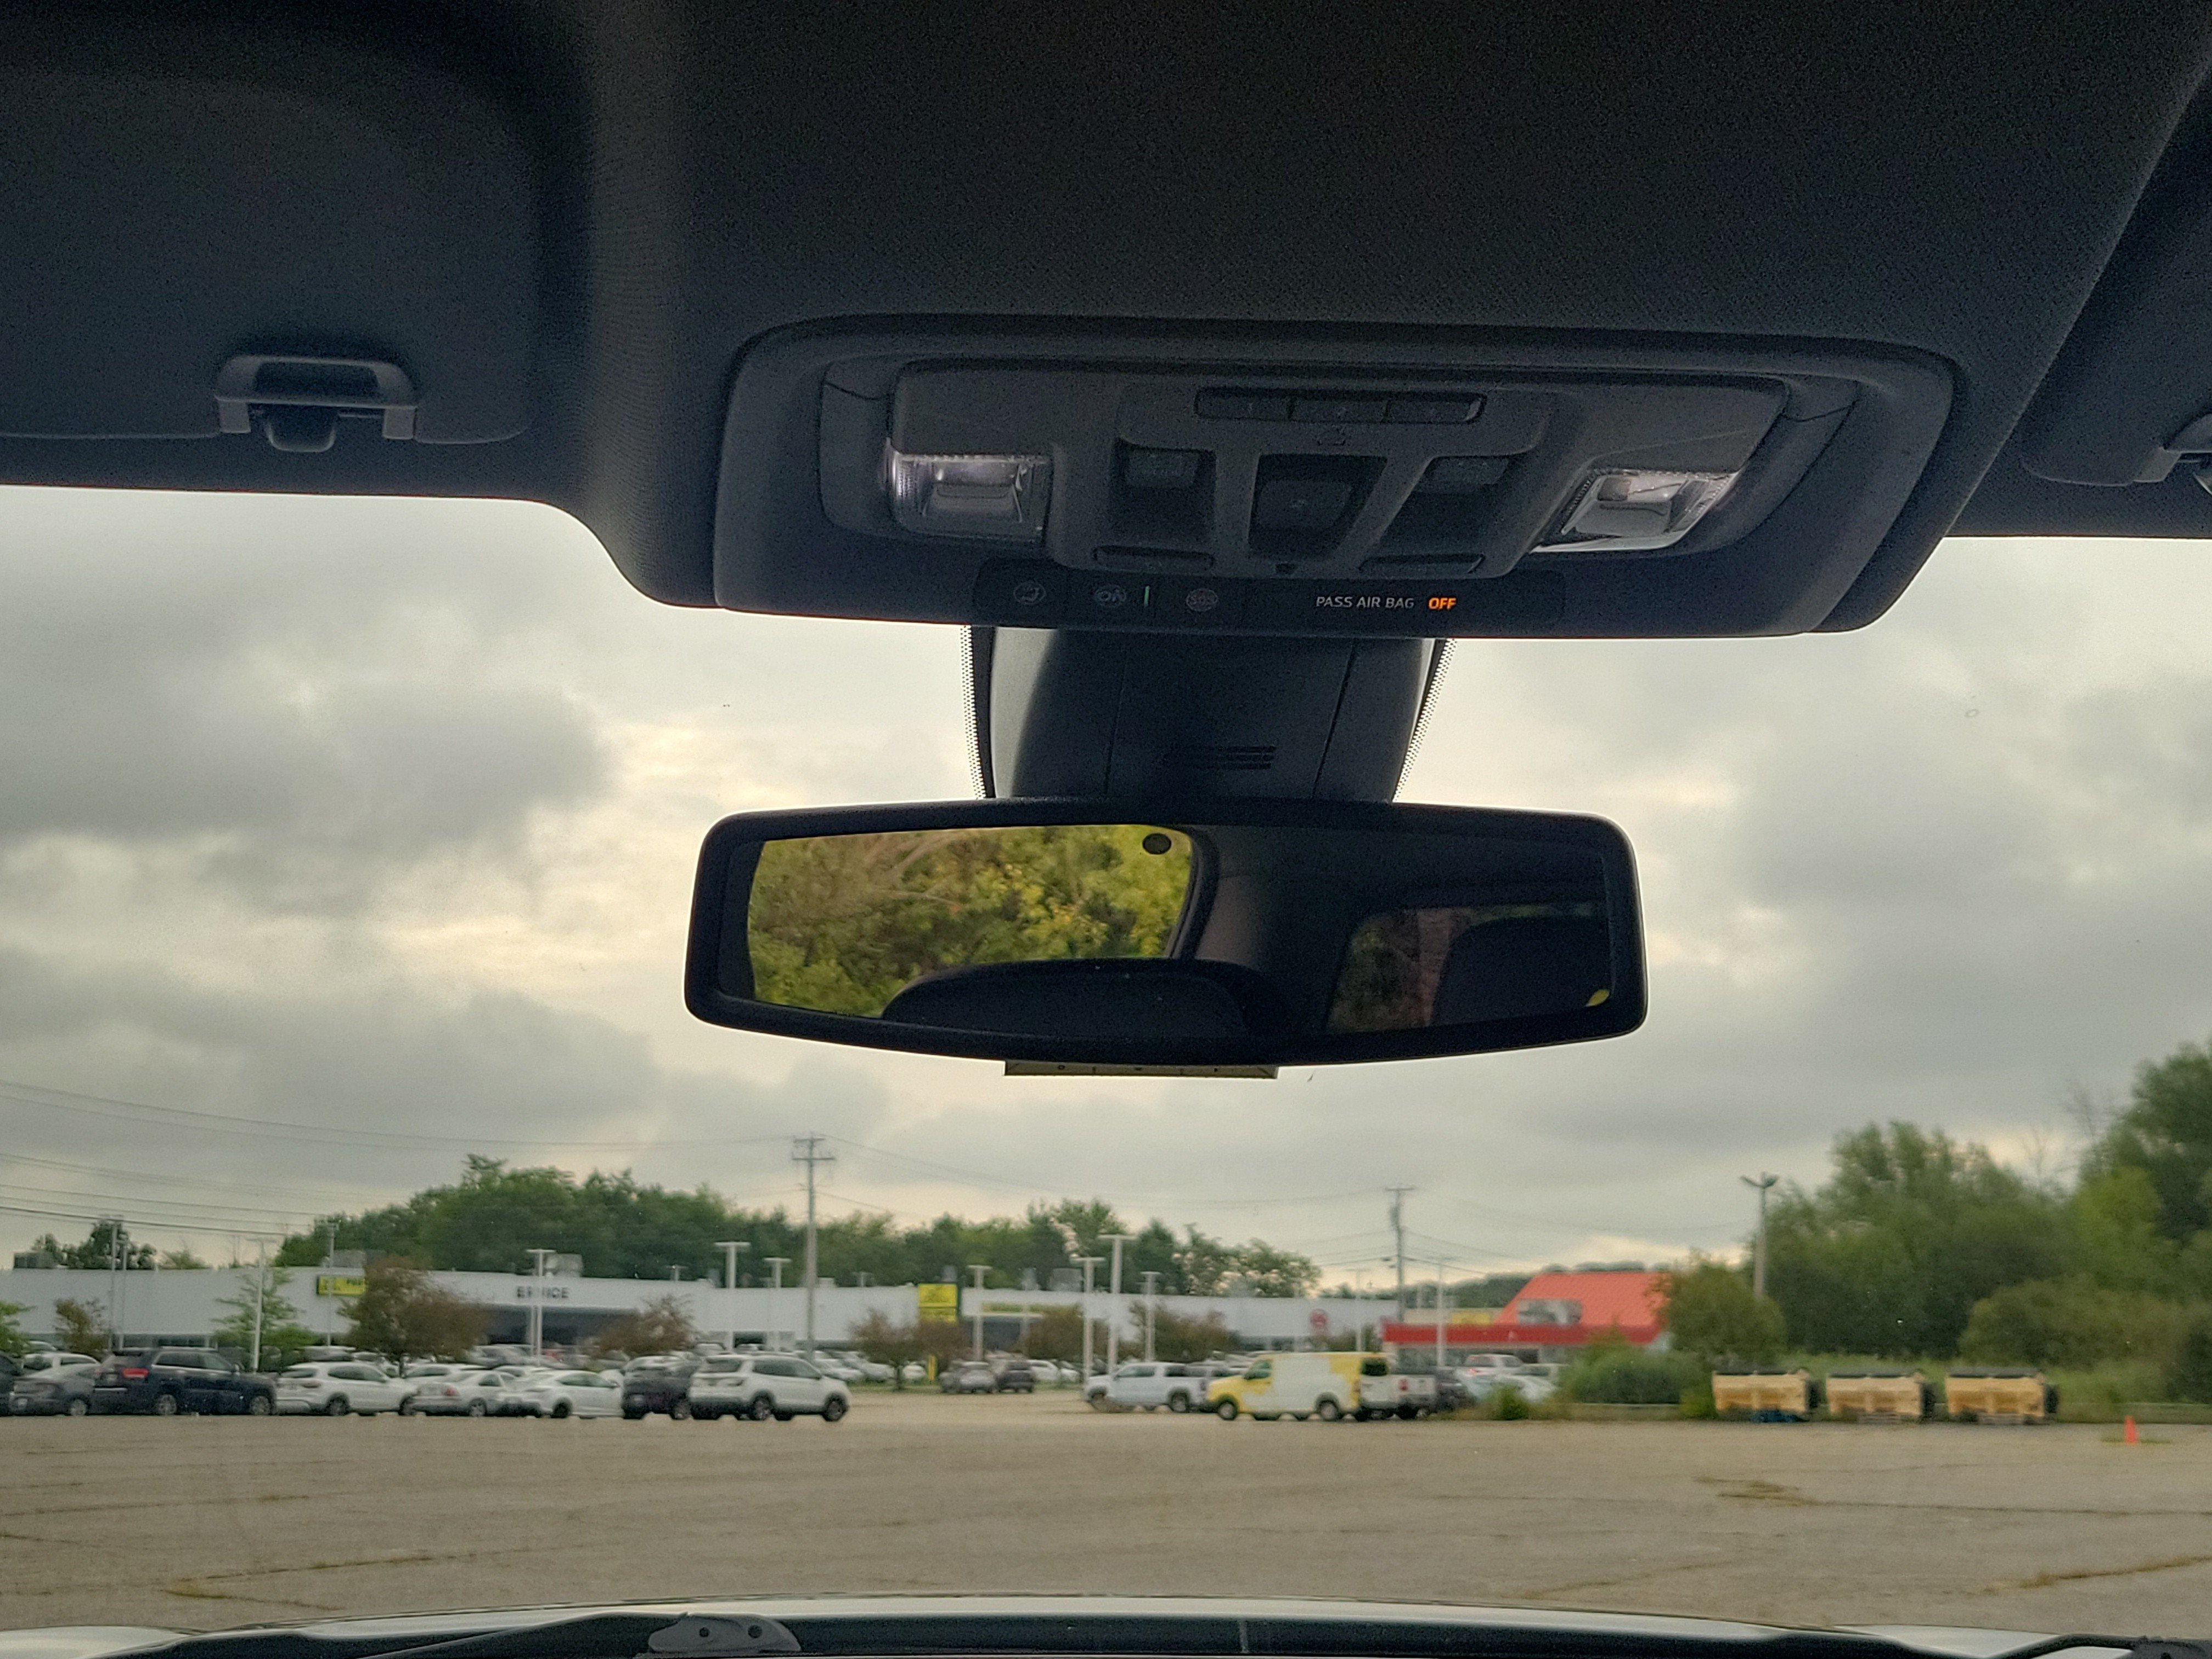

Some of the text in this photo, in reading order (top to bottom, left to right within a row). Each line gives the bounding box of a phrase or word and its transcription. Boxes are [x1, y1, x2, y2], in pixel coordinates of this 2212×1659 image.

[1316, 596, 1414, 609] PASS AIR BAG
[1428, 597, 1458, 610] OFF
